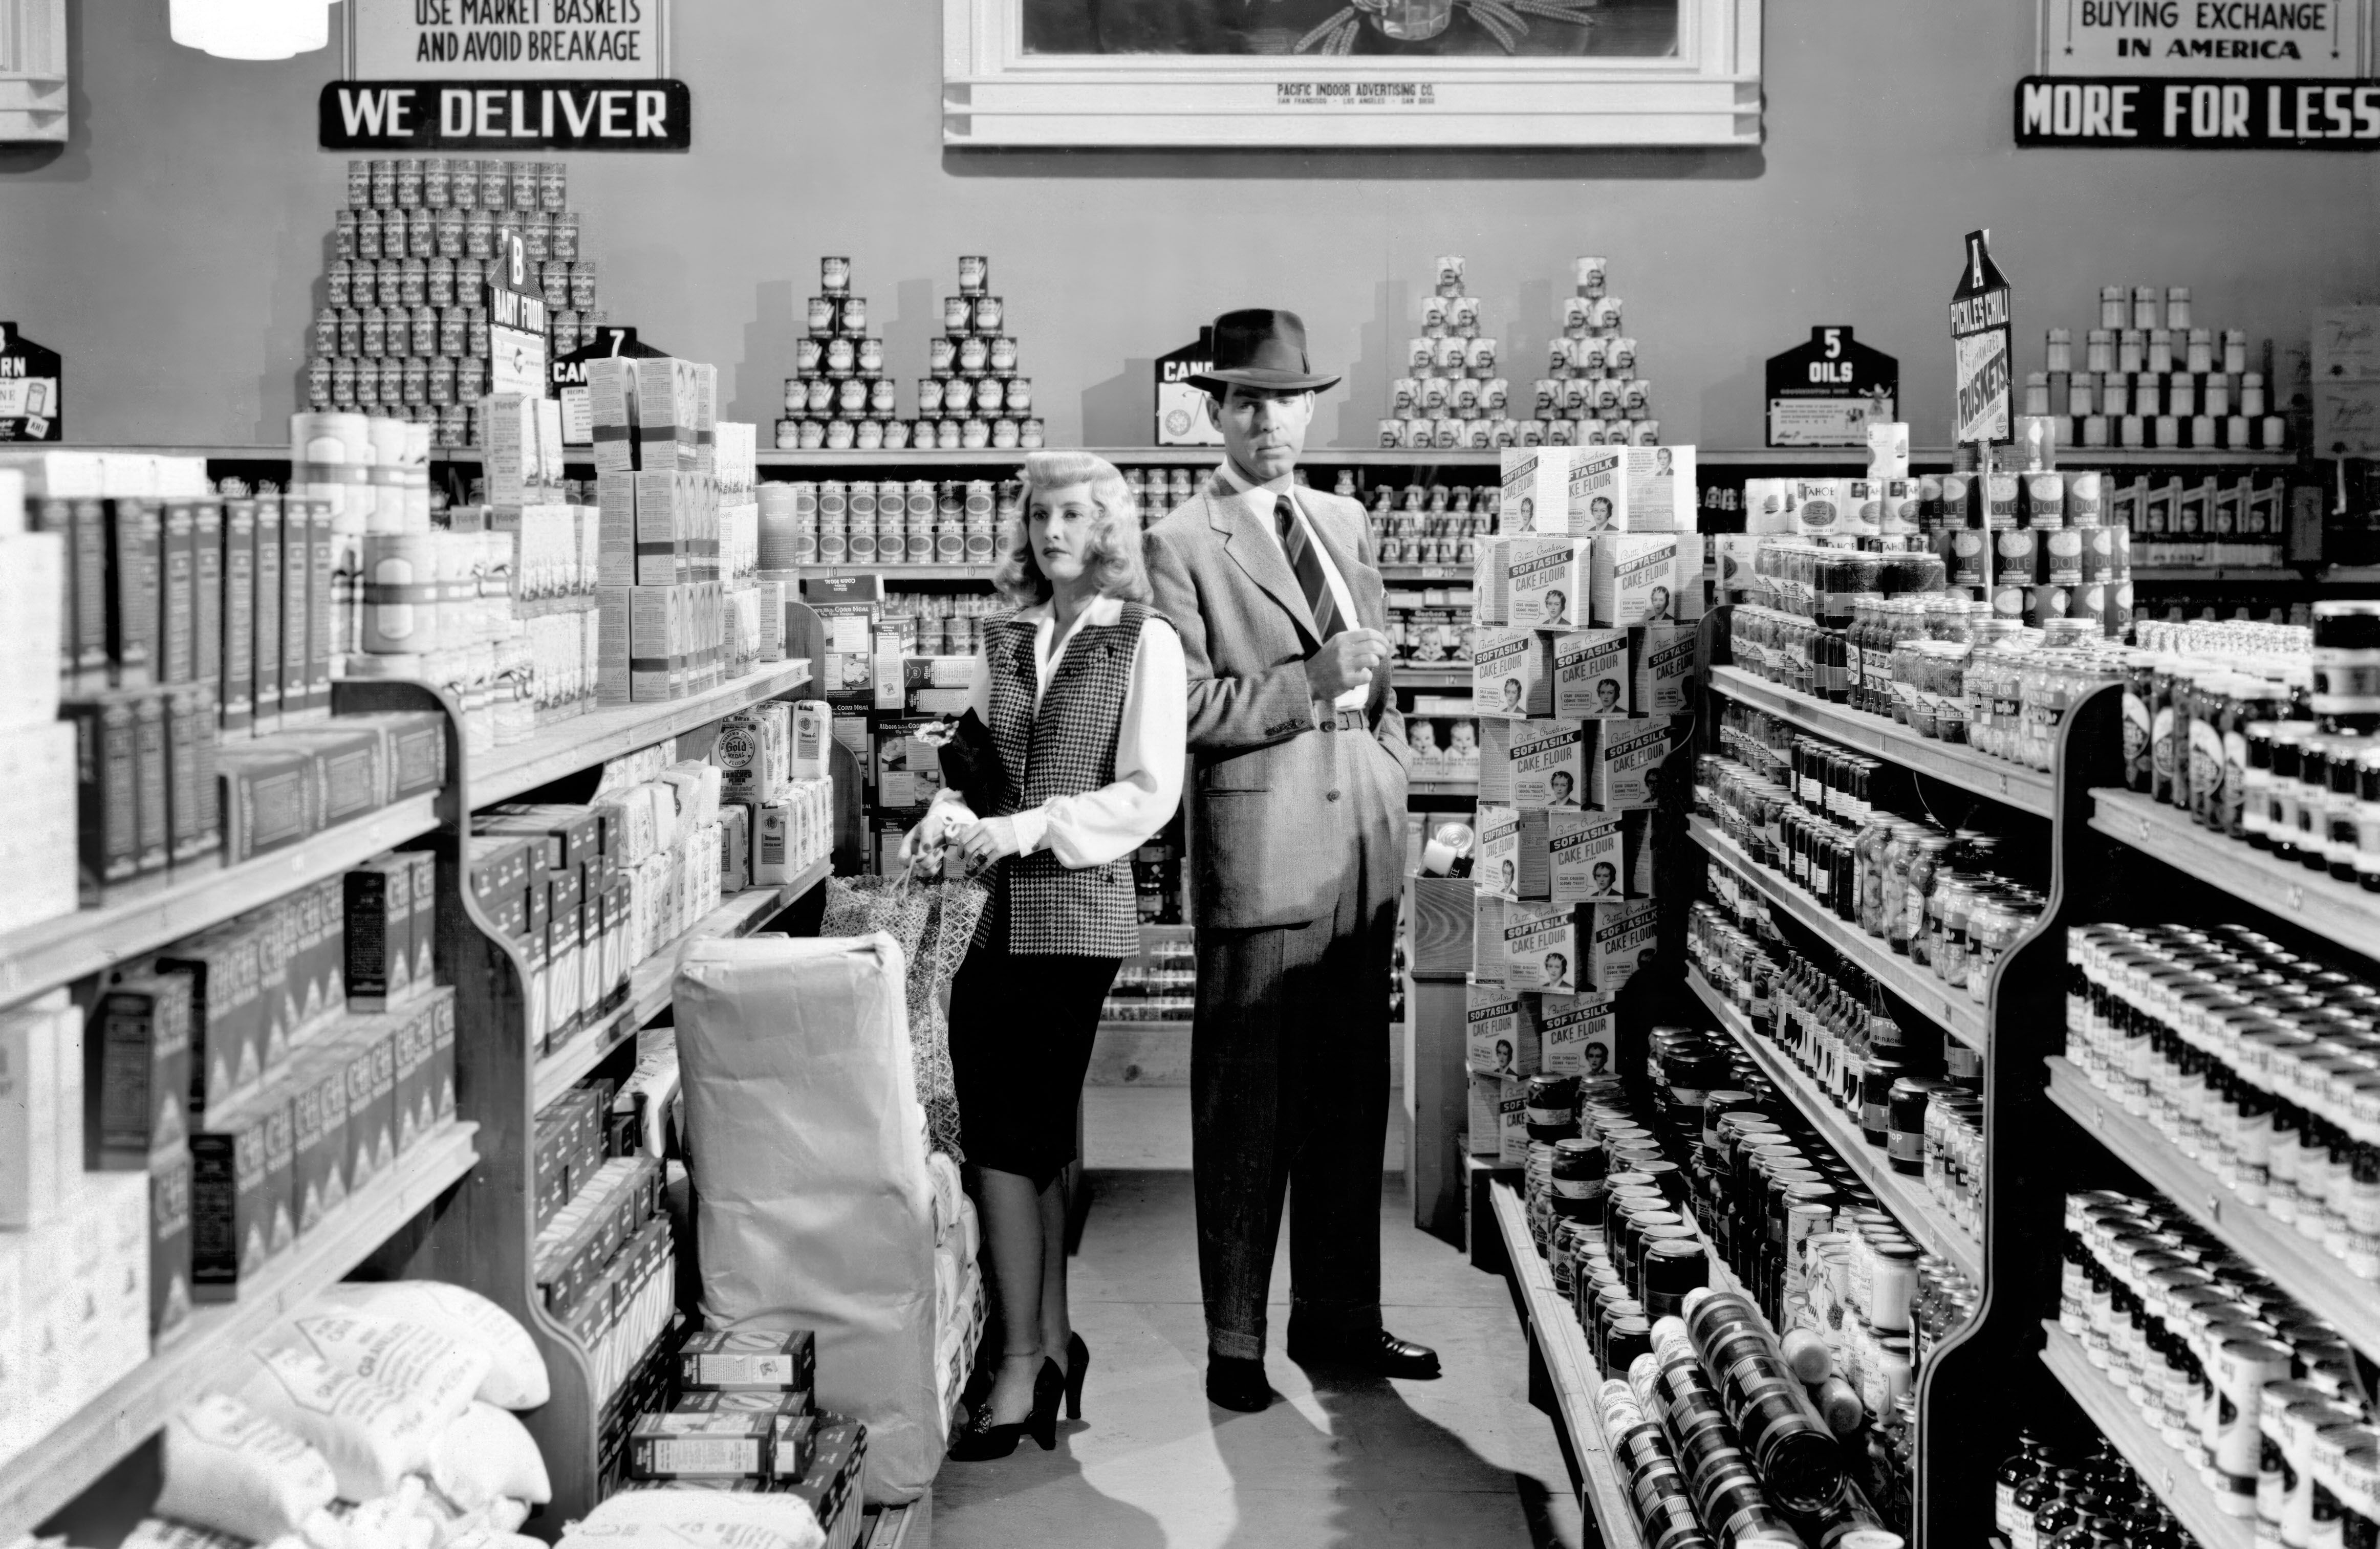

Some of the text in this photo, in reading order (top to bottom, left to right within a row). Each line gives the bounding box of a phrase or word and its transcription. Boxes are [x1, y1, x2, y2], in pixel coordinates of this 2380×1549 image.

[416, 0, 641, 25] USE MARKET BASKETS
[2082, 1, 2327, 31] BUYING EXCHANGE
[417, 30, 641, 62] AND AVOID BREAKAGE
[2117, 38, 2302, 60] IN AMERICA
[1278, 83, 1311, 96] PACIFIC
[1316, 83, 1351, 96] INDOOR
[1356, 83, 1416, 96] ADVERTISING
[338, 89, 668, 138] WE DELIVER
[2023, 84, 2380, 139] MORE FOR LESS
[1972, 238, 1984, 289] A
[1950, 288, 2009, 336] PICKLES CHILI
[610, 330, 625, 358] 7
[1824, 329, 1842, 359] 5
[553, 362, 588, 382] CAN
[1809, 361, 1853, 383] OILS
[1959, 347, 2006, 430] RUSKETS
[1569, 460, 1613, 483] FTASILK
[1569, 472, 1611, 497] KE FLOUR
[1804, 485, 1834, 501] TAHOE
[1943, 502, 1965, 513] OLE
[1993, 501, 2017, 513] OLE
[1511, 551, 1569, 576] SOFTASILK
[1618, 547, 1672, 576] SOFTASILK
[1957, 558, 1980, 570] OLE
[1516, 565, 1566, 592] CAKE FLOUR
[1621, 561, 1670, 591] CAKE FLOUR
[1476, 640, 1525, 663] SOFTASILK
[1557, 640, 1621, 667] SOFTASILK
[1652, 641, 1694, 665] SOFTASIL
[1479, 654, 1522, 680] CAKE FLOUR
[1562, 653, 1618, 683] CAKE FLOUR
[1656, 652, 1694, 681] CAKE FLOU
[725, 740, 747, 752] Gold
[1513, 732, 1575, 758] SOFTASILK
[1609, 730, 1667, 757] SOFTASILK
[1517, 746, 1572, 774] CAKE FLOUR
[1613, 743, 1664, 773] CAKE FLOUR
[1553, 822, 1617, 850] SOFTASILK
[1557, 837, 1614, 866] CAKE FLOUR
[1507, 914, 1569, 939] SOFTASILK
[1600, 910, 1658, 940] SOFTASILK
[1511, 928, 1566, 954] CAKE FLOUR
[1605, 934, 1627, 955] CAKE
[1469, 1002, 1513, 1021] SOFTASILK
[1546, 1003, 1609, 1030] SOFTASILK
[1473, 1017, 1512, 1037] CAKE FLOUR
[1550, 1018, 1607, 1045] CAKE FLOUR
[1885, 1021, 1897, 1030] TO
[1506, 1112, 1525, 1127] CAKE
